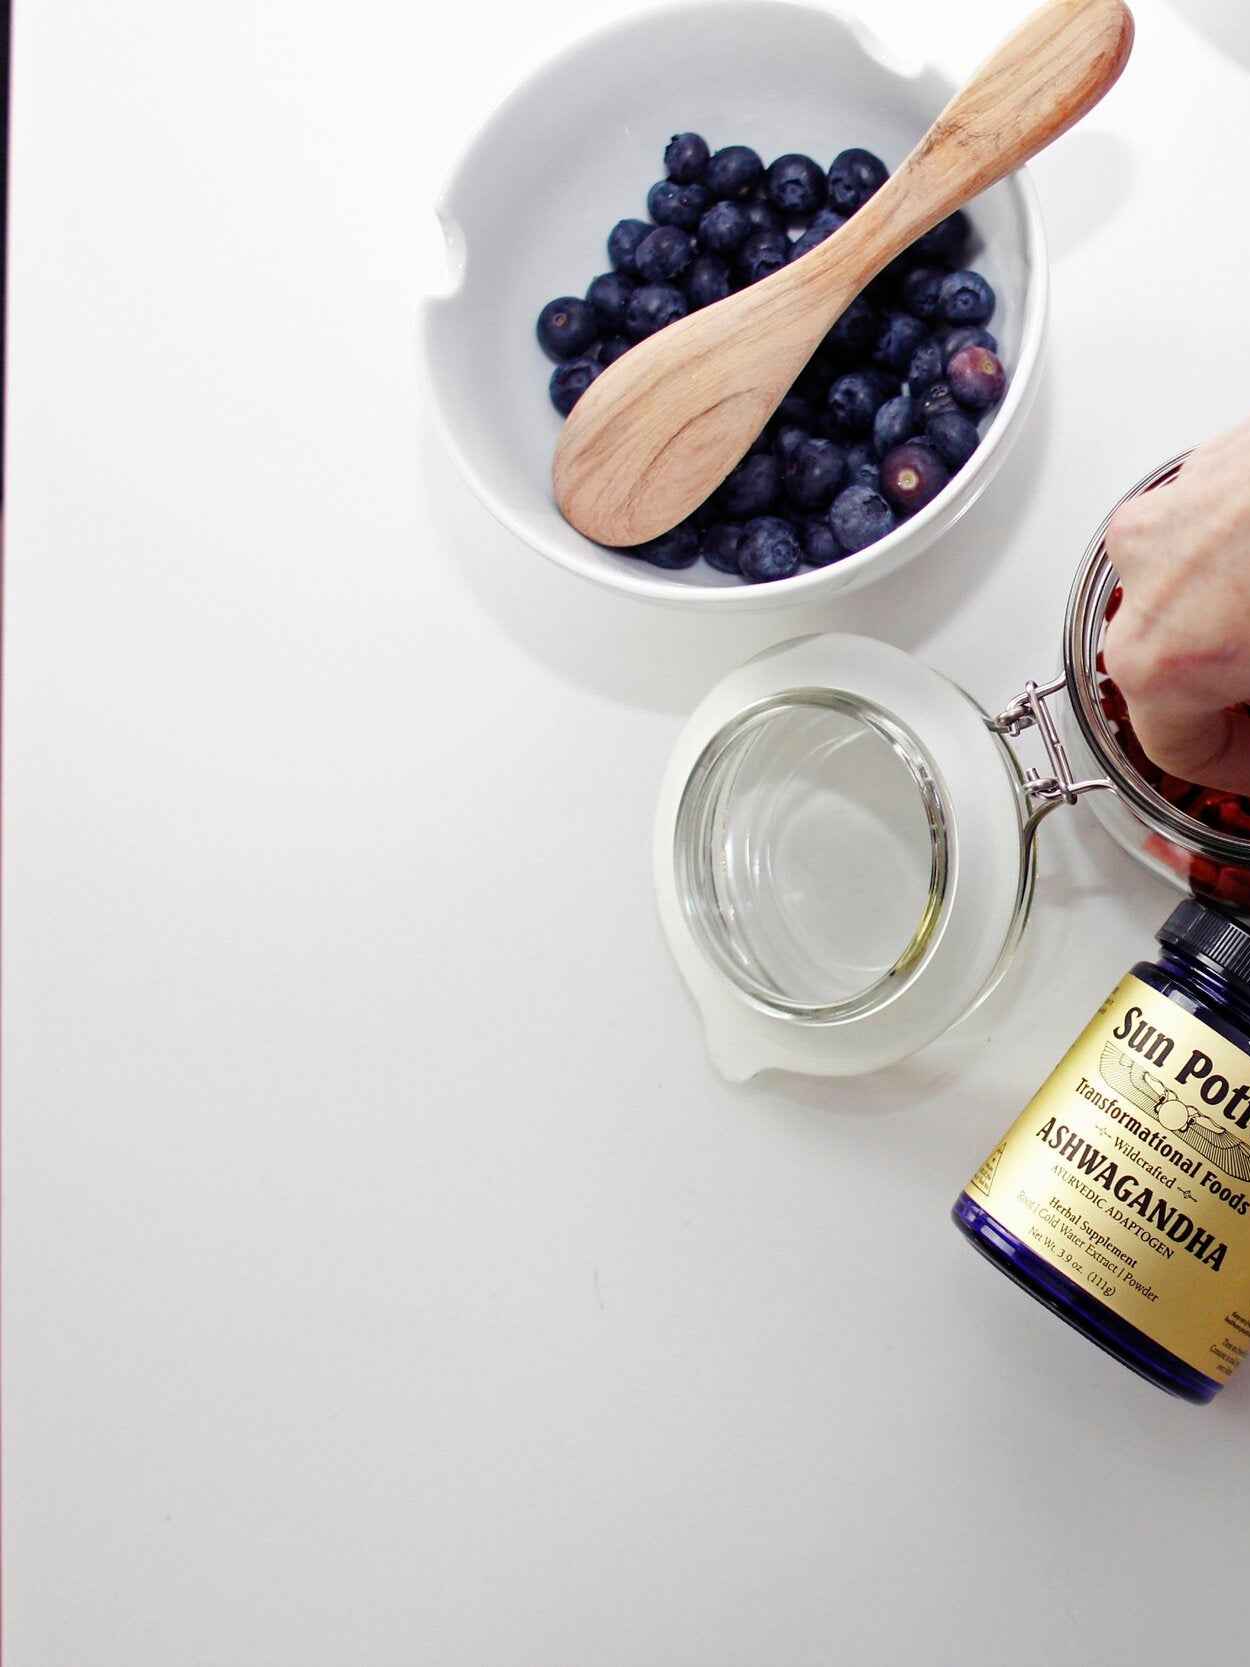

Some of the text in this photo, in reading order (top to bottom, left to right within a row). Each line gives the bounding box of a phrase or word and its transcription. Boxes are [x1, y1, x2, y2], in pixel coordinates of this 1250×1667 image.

[1113, 1007, 1175, 1067] Sun
[1075, 1077, 1203, 1178] Transformational
[1200, 1171, 1250, 1216] Foods
[1114, 1136, 1177, 1189] Wildcrafted
[1036, 1117, 1229, 1272] ASHWAGANDHA
[1049, 1197, 1138, 1268] Herbal Supplement
[1051, 1164, 1107, 1209] AYURVEDIC
[1105, 1206, 1175, 1260] ADAPTOGEN
[1028, 1226, 1044, 1241] Net
[1058, 1249, 1073, 1263] 3.9
[1072, 1261, 1083, 1273] oz.
[1087, 1272, 1117, 1296] (111g)
[1039, 1208, 1060, 1228] Cold
[1060, 1223, 1086, 1248] Water
[1085, 1244, 1118, 1273] Extract
[1123, 1272, 1160, 1302] Powder
